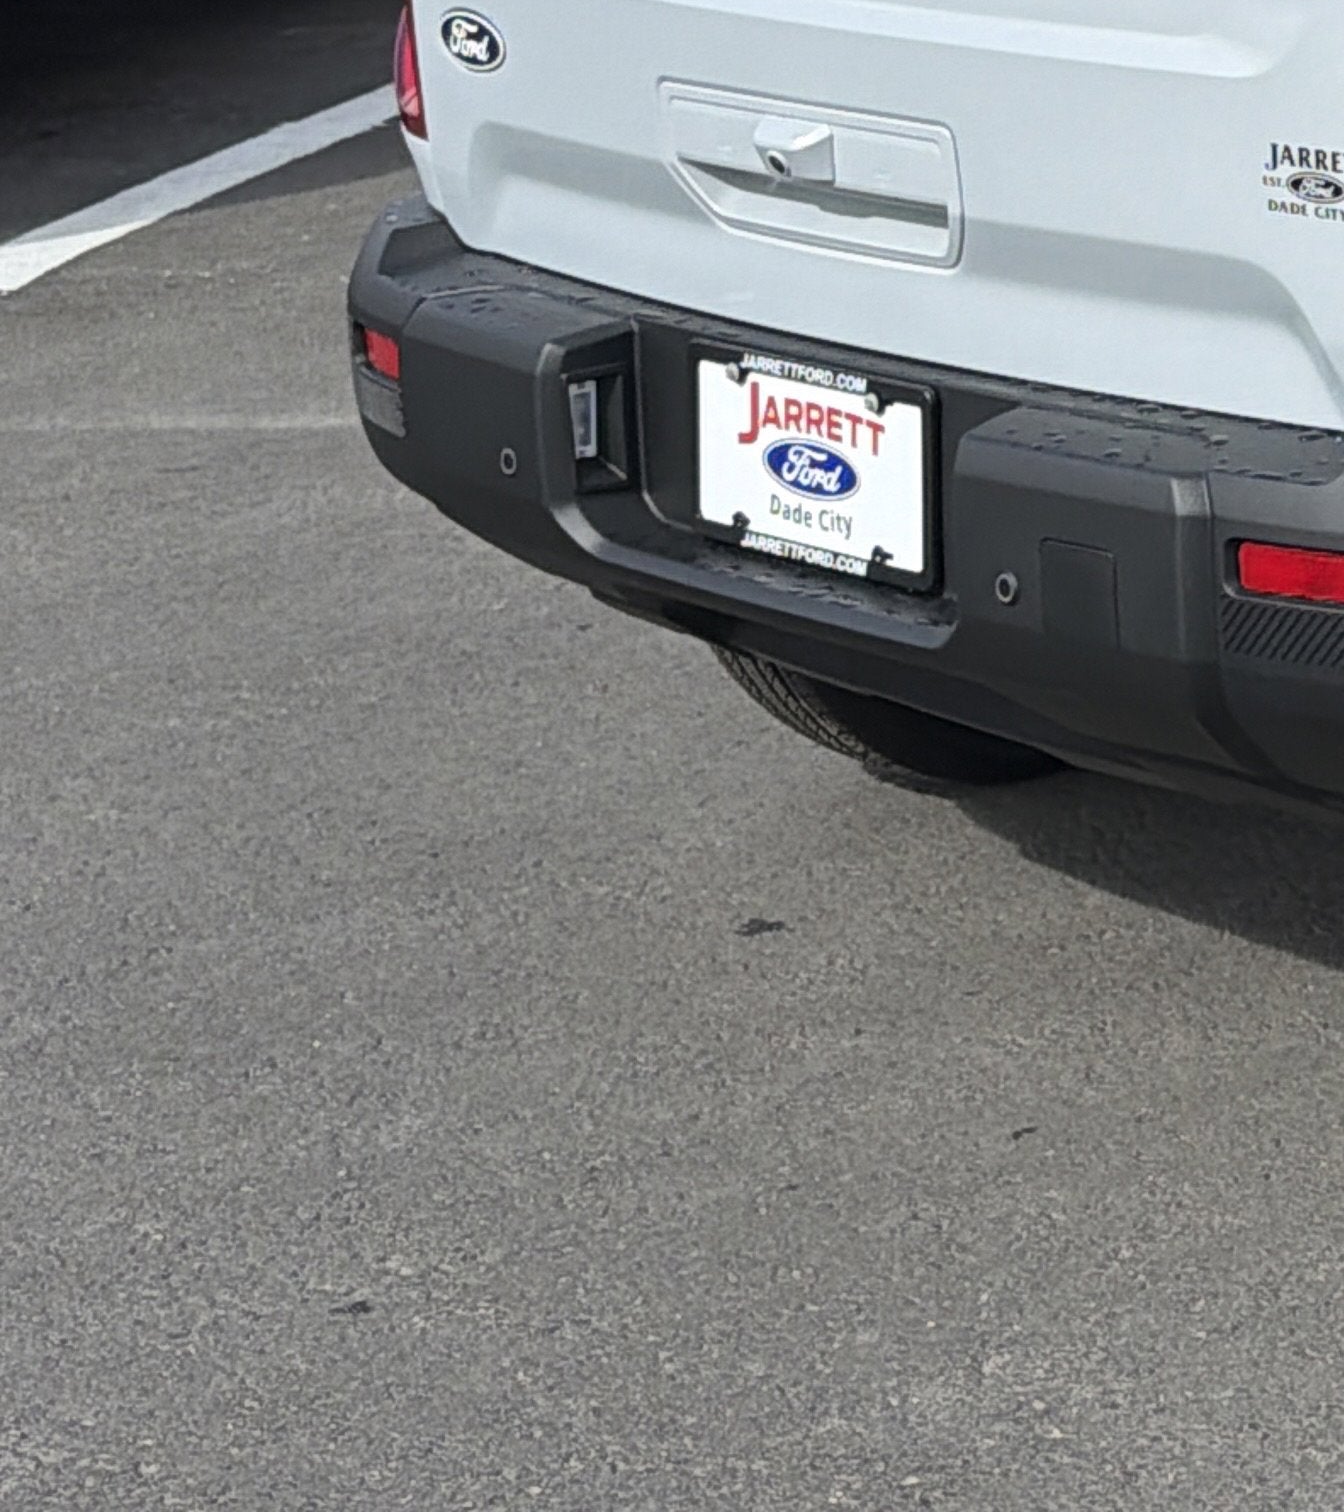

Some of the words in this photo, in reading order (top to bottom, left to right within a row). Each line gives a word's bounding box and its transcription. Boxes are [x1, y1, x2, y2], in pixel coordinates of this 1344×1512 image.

[1268, 199, 1308, 216] DADE
[740, 353, 867, 393] JARRETTFORD.COM
[738, 381, 885, 456] JARRETT
[781, 445, 843, 493] Ford
[770, 494, 813, 528] Dade
[818, 509, 853, 540] City
[740, 532, 868, 576] JARRETTFORD.COM
